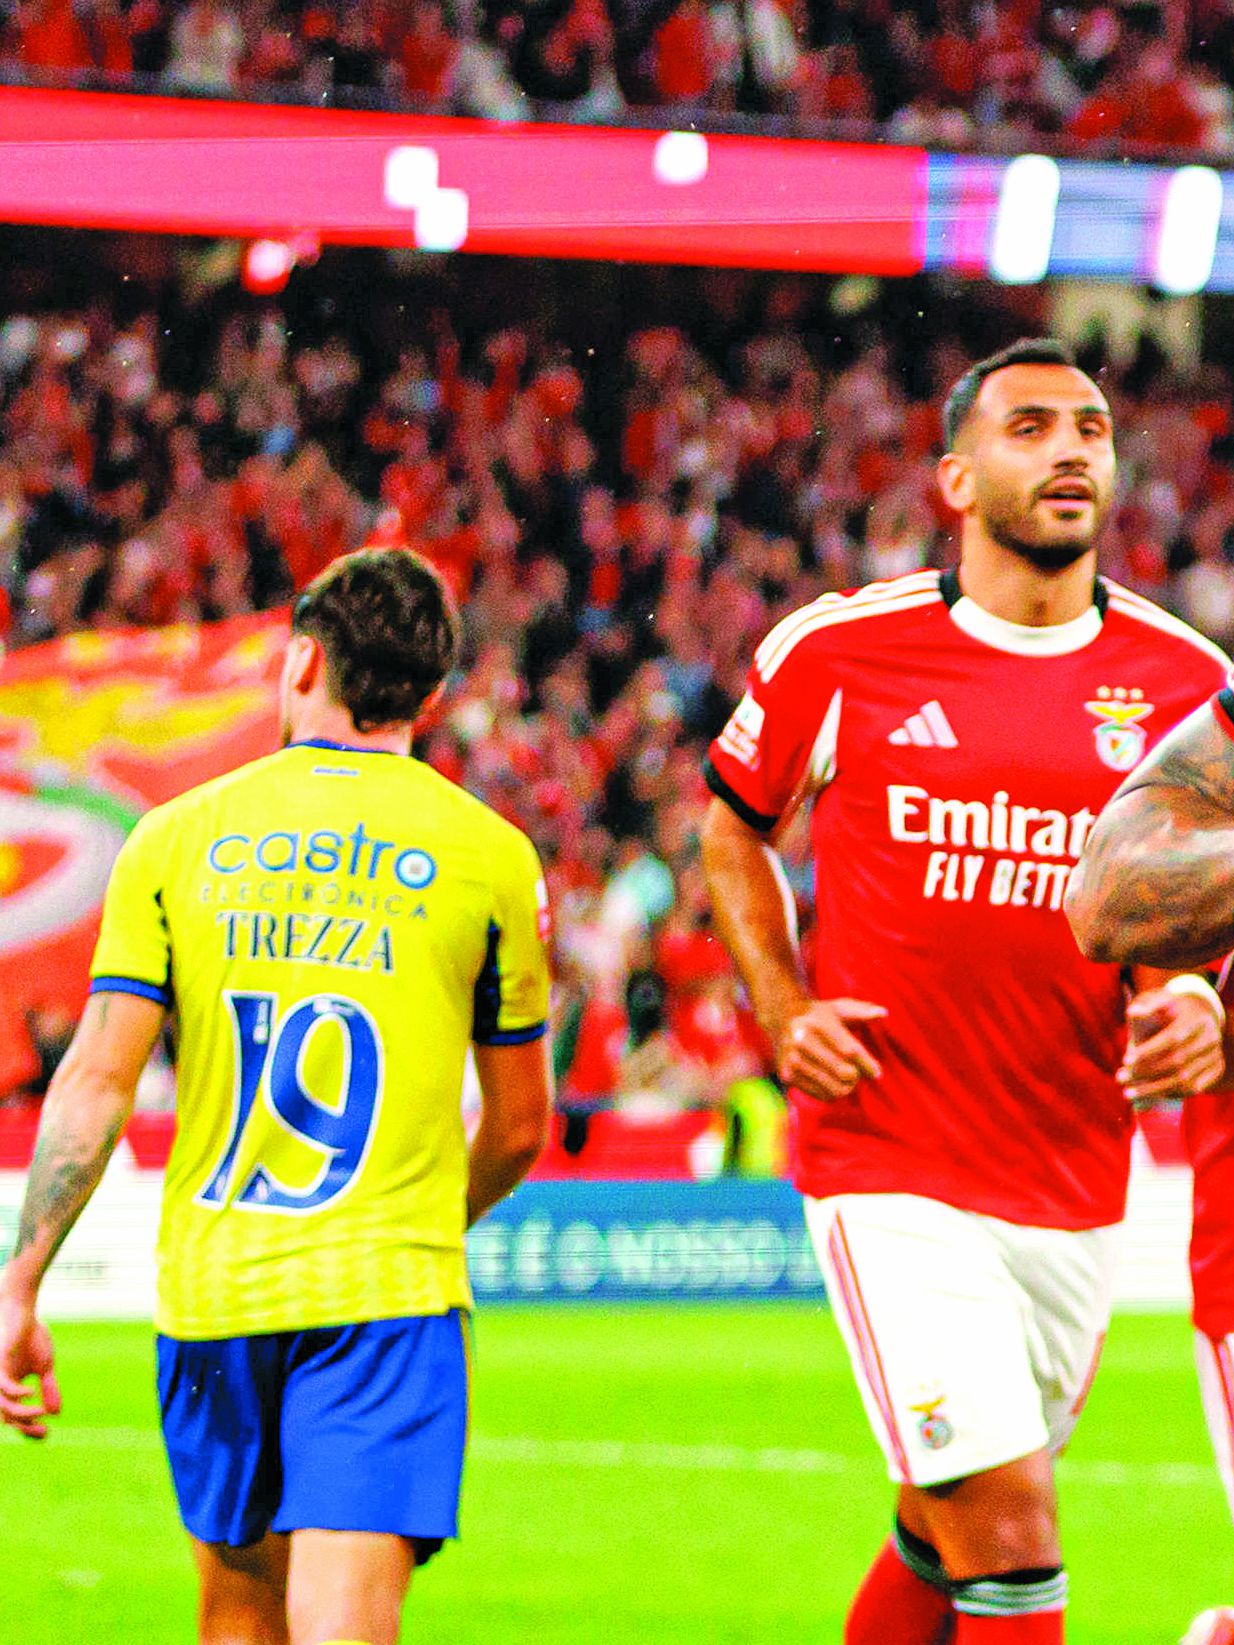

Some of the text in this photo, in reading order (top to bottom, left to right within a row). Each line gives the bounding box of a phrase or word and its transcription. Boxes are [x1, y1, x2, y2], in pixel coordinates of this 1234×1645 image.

[887, 784, 1098, 858] Emirat
[207, 822, 438, 890] castro
[923, 851, 1073, 912] FLY BETT
[215, 909, 395, 976] TREZZA
[191, 988, 386, 1218] 19
